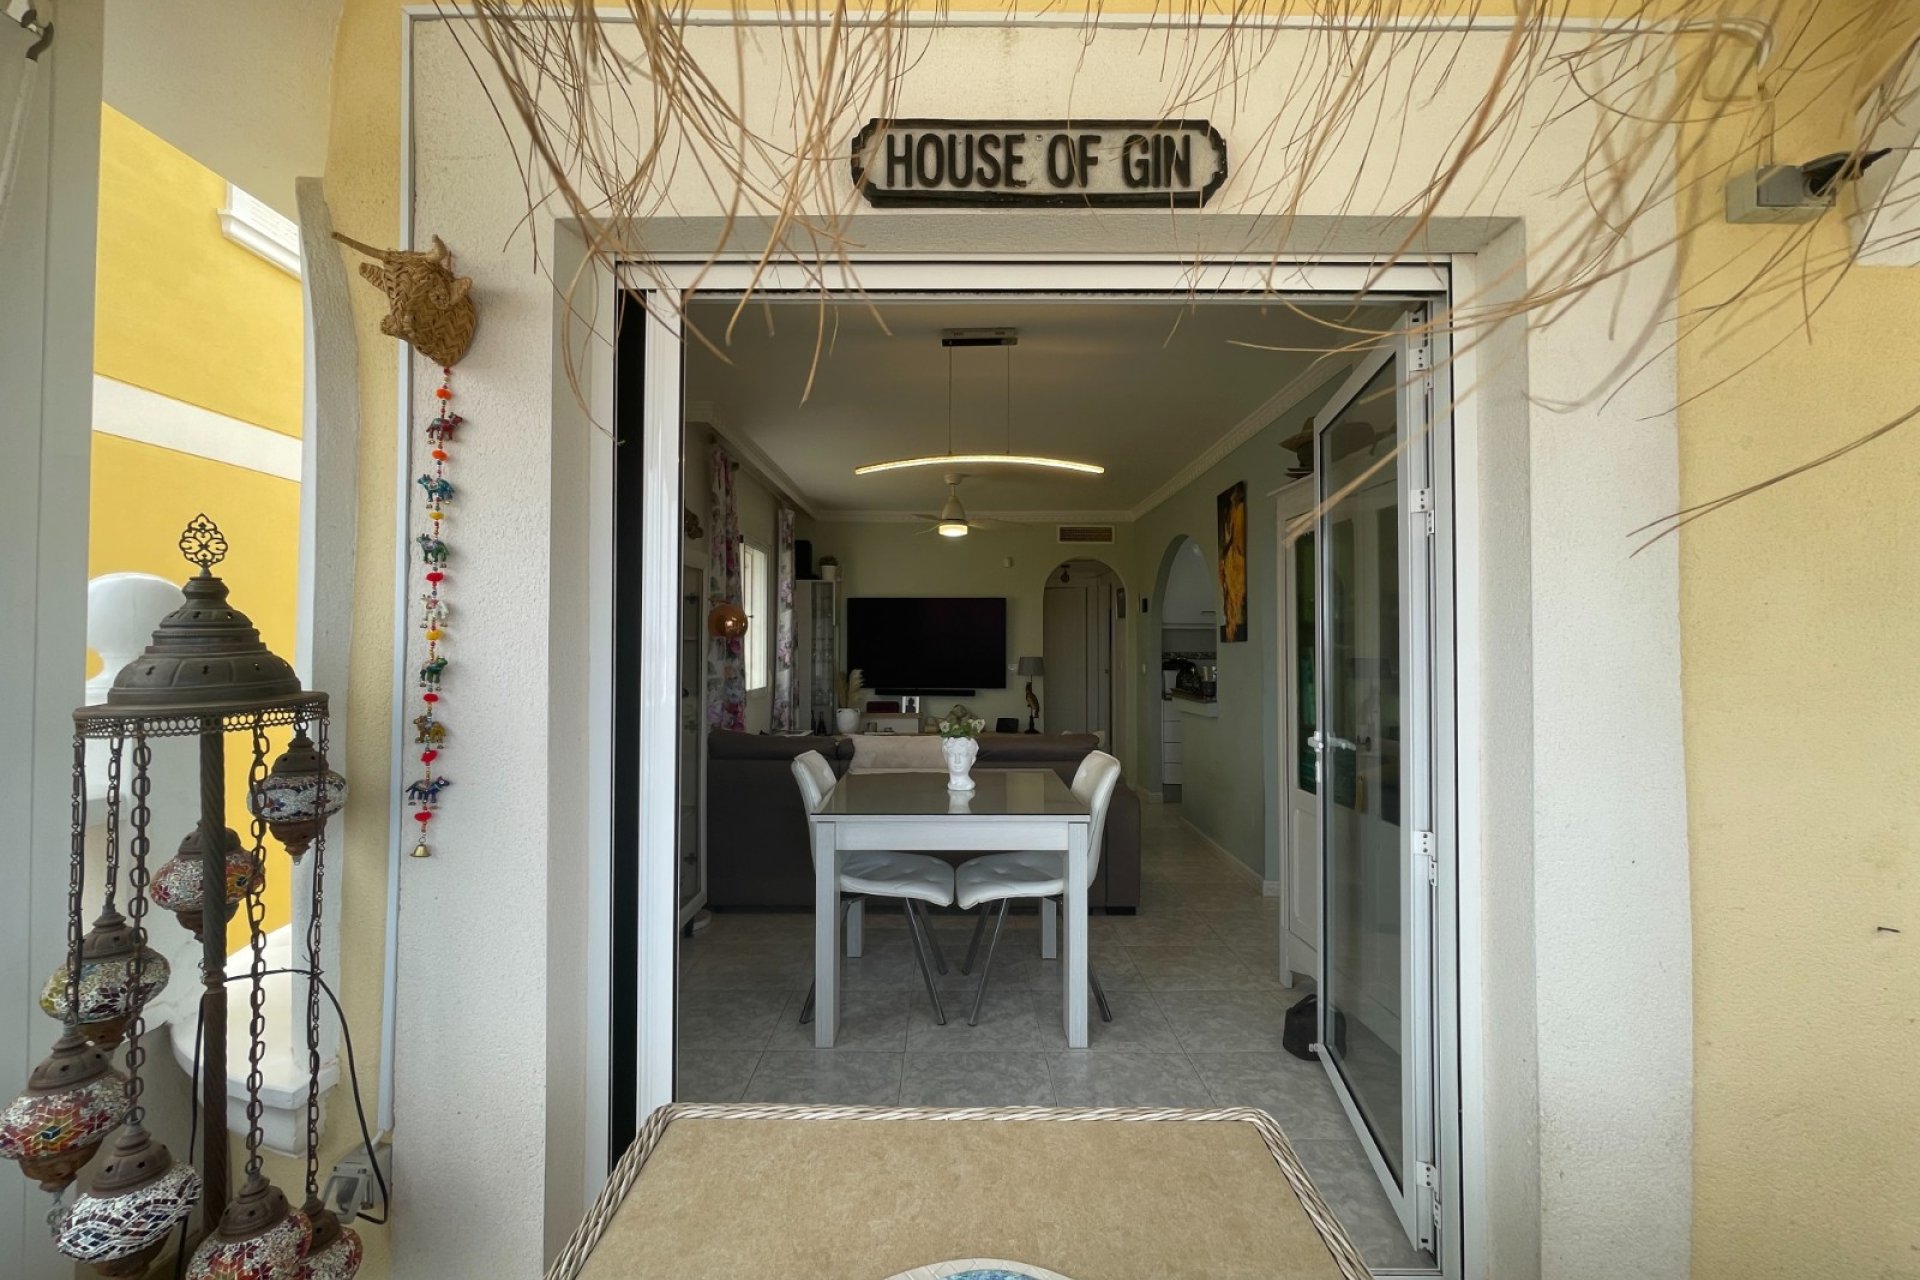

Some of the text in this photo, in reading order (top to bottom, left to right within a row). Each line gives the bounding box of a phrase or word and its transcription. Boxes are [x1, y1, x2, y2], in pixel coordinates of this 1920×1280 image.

[886, 133, 1192, 188] HOUSE OF GIN
